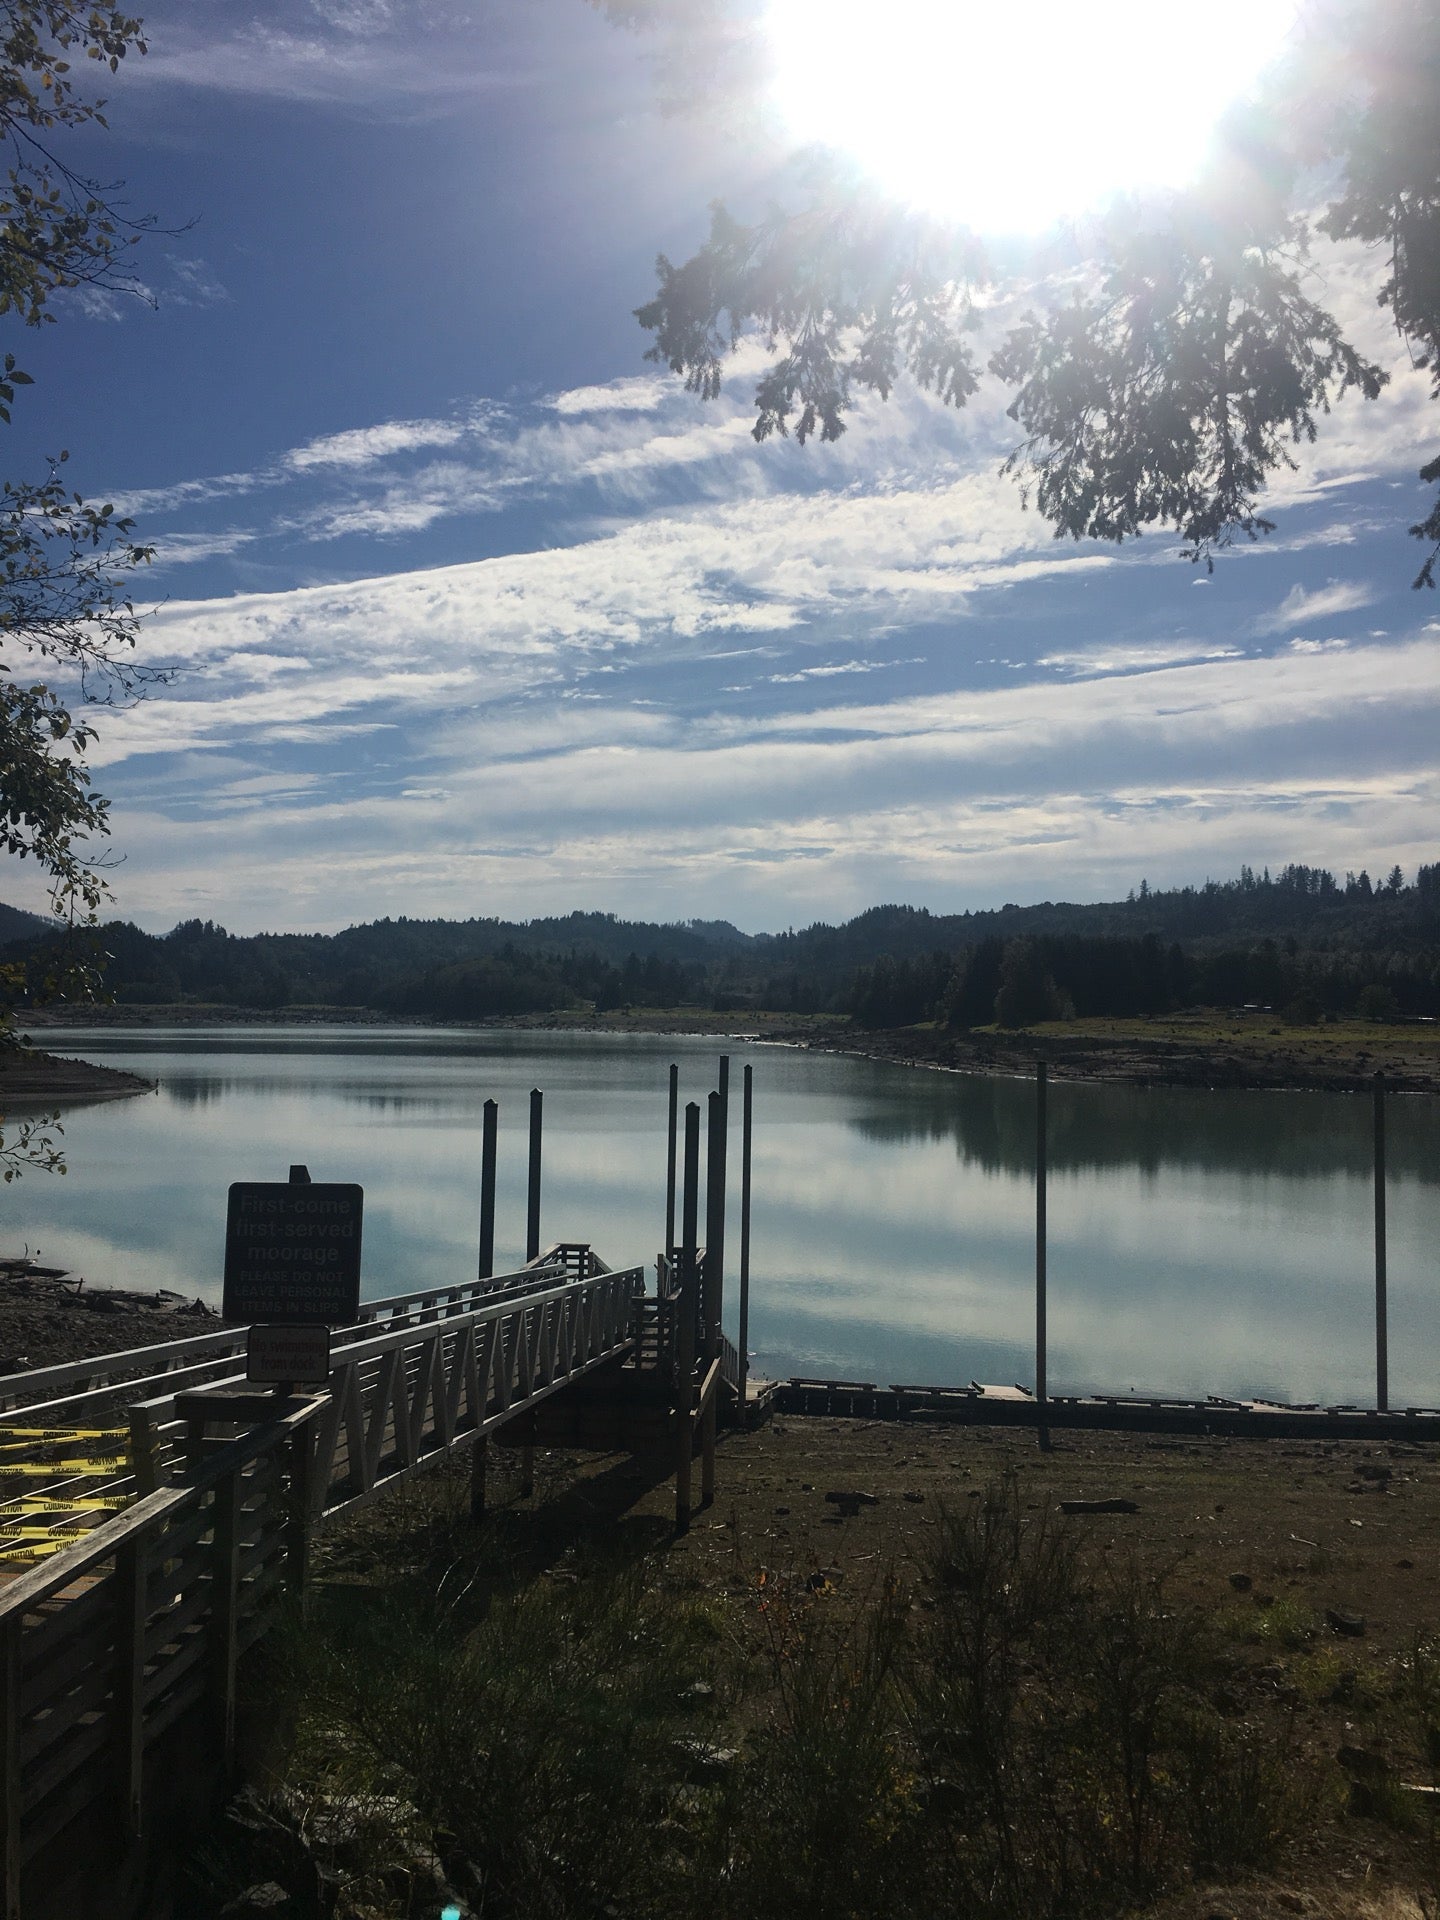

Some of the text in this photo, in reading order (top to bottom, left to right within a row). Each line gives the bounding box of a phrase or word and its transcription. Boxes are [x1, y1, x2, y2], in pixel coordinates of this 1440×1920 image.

[240, 1194, 351, 1213] First-come
[235, 1218, 353, 1237] first-served
[248, 1247, 339, 1265] moorage
[240, 1270, 344, 1282] PLEASE DO NOT
[233, 1285, 348, 1298] LEAVE PERSONAL
[242, 1301, 339, 1313] ITEMS IN SLIPS
[261, 1354, 287, 1370] from
[0, 1505, 22, 1513] UTION
